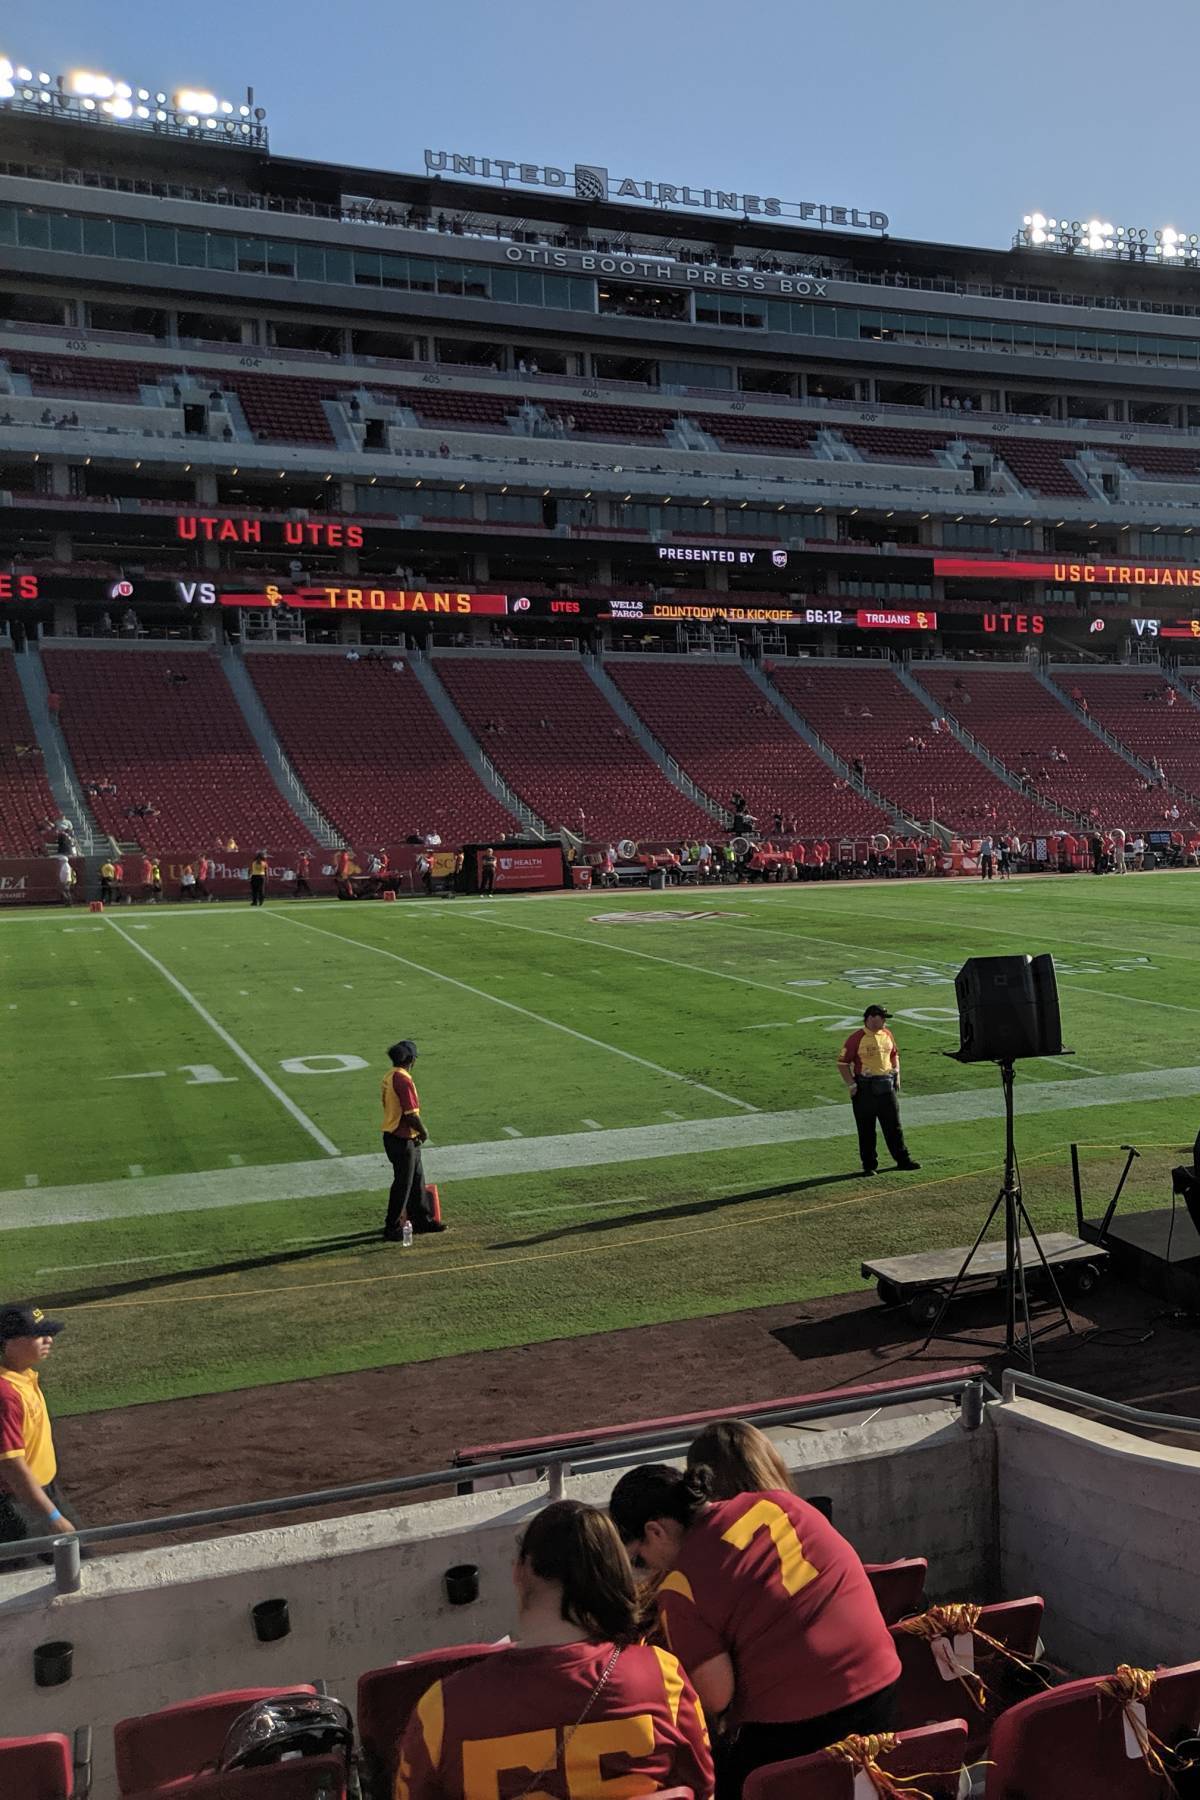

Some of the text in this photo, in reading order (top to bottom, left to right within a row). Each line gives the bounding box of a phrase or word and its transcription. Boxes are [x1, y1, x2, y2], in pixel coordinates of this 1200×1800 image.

[424, 149, 890, 230] UNITED AIRLINES FIELD
[506, 247, 827, 297] OTIS BOOTH PRESS BOX
[65, 340, 87, 351] 403
[239, 358, 262, 368] 404
[422, 374, 441, 385] 405
[582, 389, 599, 399] 406
[177, 516, 364, 548] UTAH UTES
[659, 548, 755, 563] PRESENTED BY
[1054, 564, 1095, 583] USC
[179, 582, 217, 604] VS
[325, 587, 472, 614] TROJANS
[551, 601, 580, 613] UTES
[610, 600, 644, 610] WELLS
[611, 610, 644, 619] FARGO
[654, 605, 793, 621] COUNTDOWN TO KICKOFF
[806, 609, 843, 624] 66:12
[865, 613, 911, 625] TROJANS
[984, 614, 1044, 633] UTES
[1134, 619, 1158, 636] VS
[513, 858, 543, 866] HEALTH
[721, 1499, 819, 1597] 7
